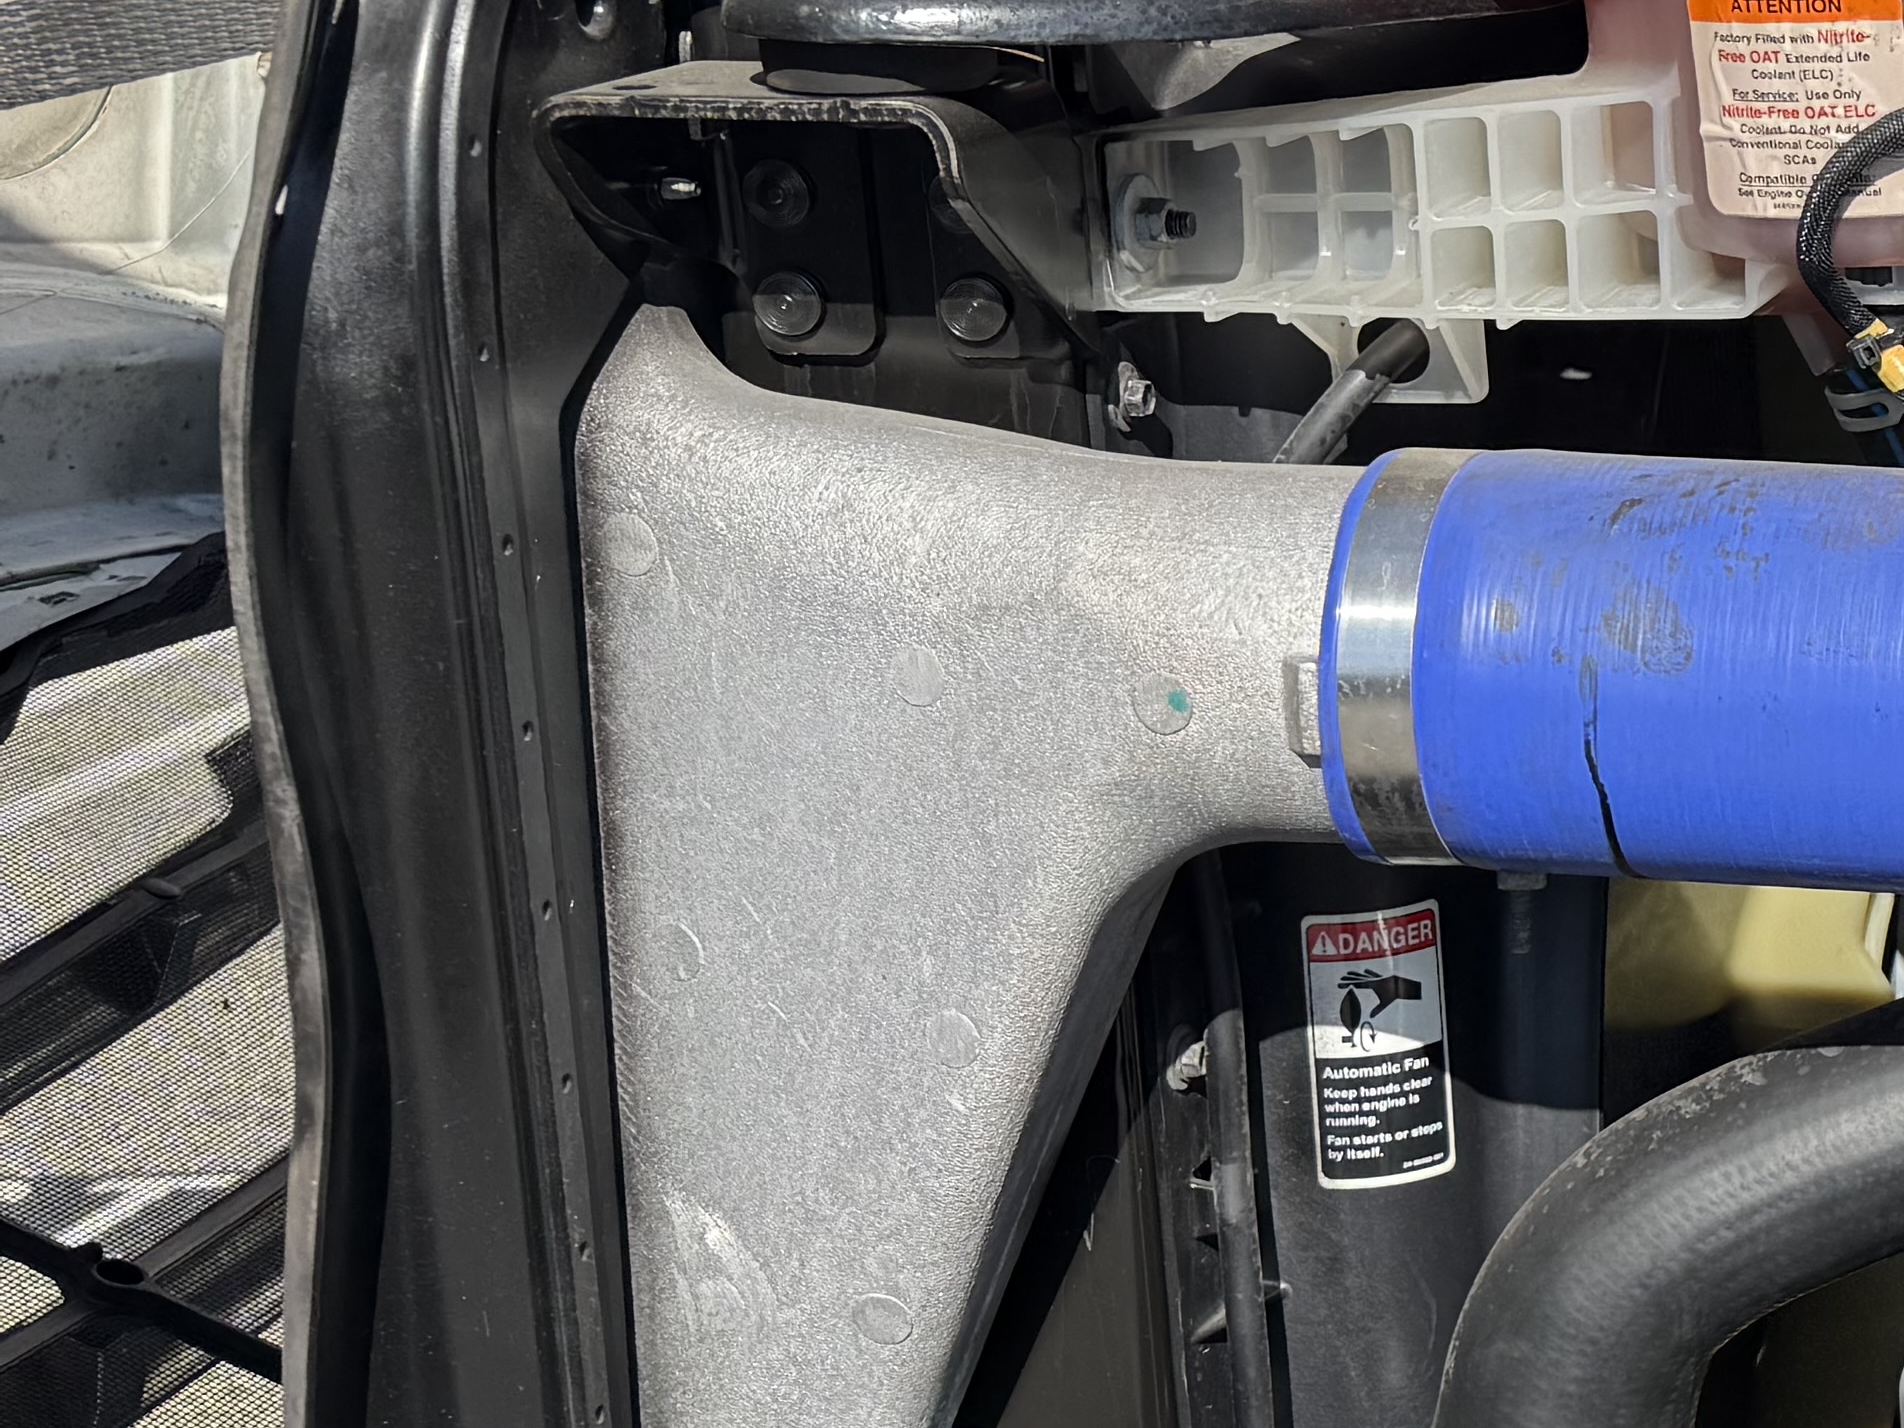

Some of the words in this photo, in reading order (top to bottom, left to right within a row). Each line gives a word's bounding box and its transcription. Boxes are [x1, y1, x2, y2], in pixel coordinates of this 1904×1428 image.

[1717, 49, 1746, 64] Free
[1750, 50, 1781, 64] OAT
[1785, 52, 1843, 64] Extended
[1846, 52, 1871, 63] Life
[1751, 69, 1796, 81] Coolant
[1799, 69, 1834, 82] (ELC)
[1805, 89, 1830, 100] Use
[1832, 89, 1862, 102] Only
[1721, 104, 1800, 120] Nitrite-Free
[1804, 105, 1838, 120] OAT
[1843, 104, 1877, 118] ELC
[1809, 124, 1831, 135] Not
[1783, 154, 1817, 165] SCAs
[1739, 172, 1808, 186] Compatible
[1337, 919, 1433, 956] DANGER
[1322, 1060, 1402, 1081] Automatic
[1404, 1056, 1430, 1073] Fan
[1323, 1086, 1358, 1102] Keep
[1360, 1083, 1401, 1099] hands
[1402, 1075, 1433, 1092] clear
[1324, 1100, 1360, 1114] when
[1361, 1097, 1407, 1114] engine
[1408, 1094, 1421, 1105] is
[1325, 1113, 1381, 1130] running.
[1326, 1133, 1351, 1147] Fan
[1352, 1131, 1394, 1145] starts
[1394, 1130, 1410, 1142] or
[1410, 1121, 1444, 1139] stops
[1327, 1148, 1344, 1162] by
[1346, 1145, 1385, 1160] itself.
